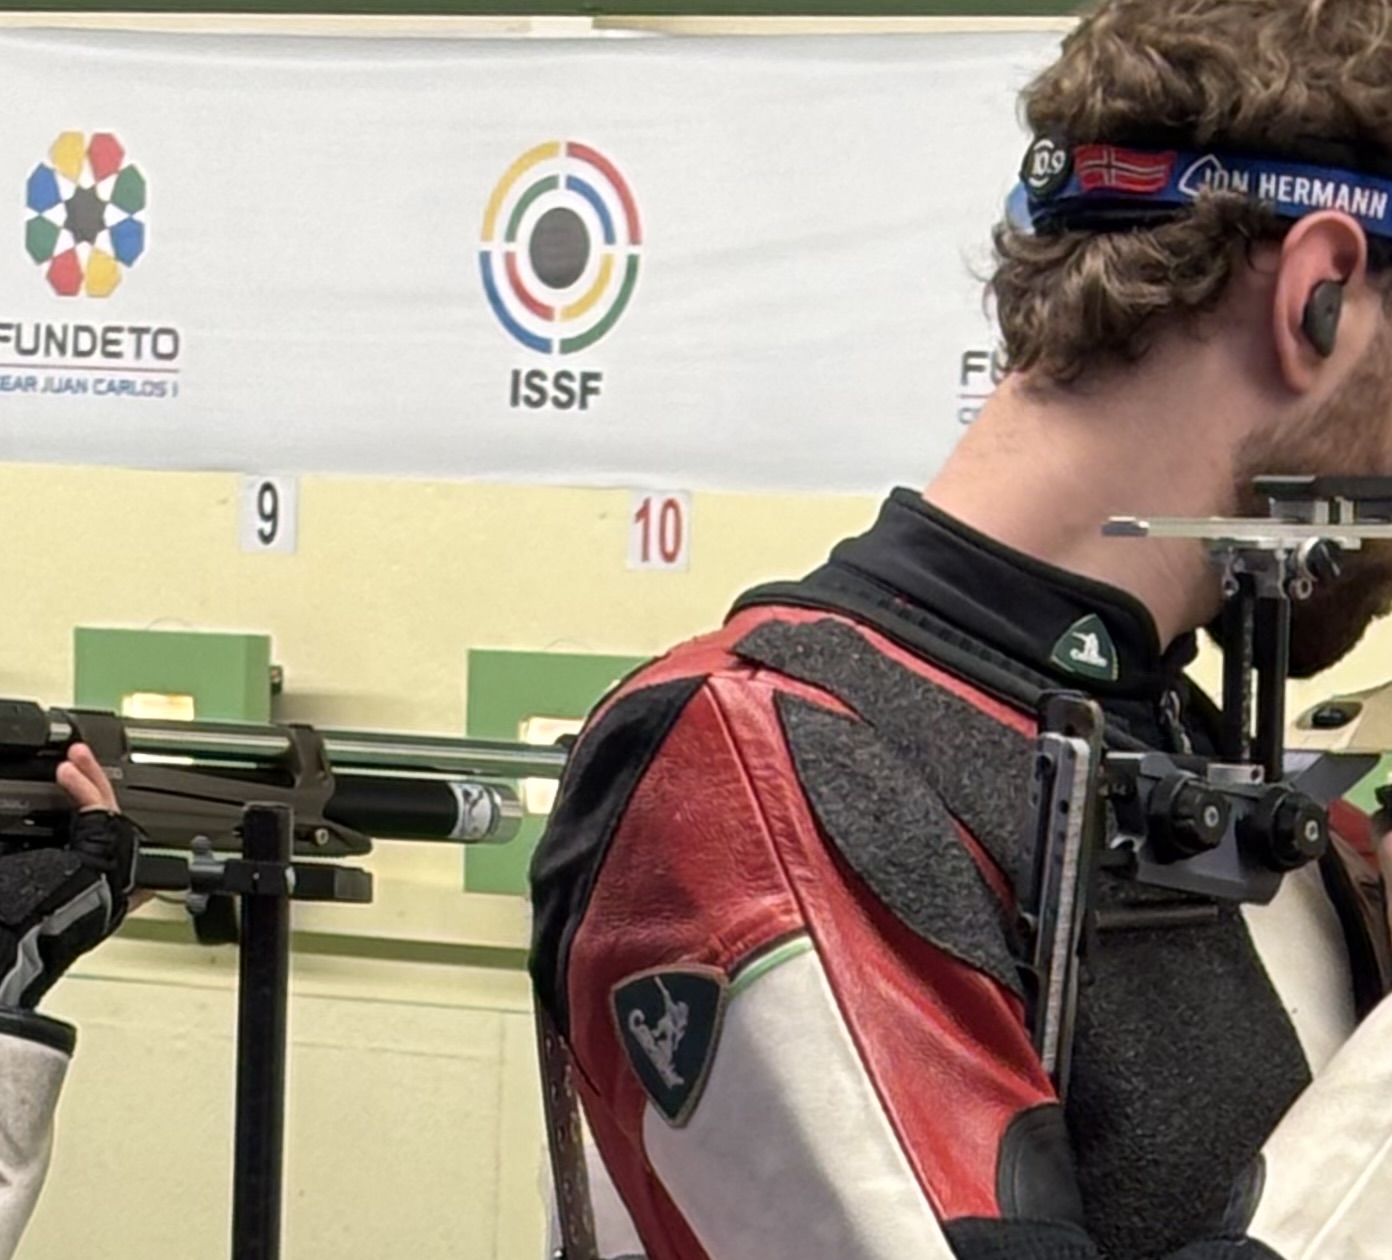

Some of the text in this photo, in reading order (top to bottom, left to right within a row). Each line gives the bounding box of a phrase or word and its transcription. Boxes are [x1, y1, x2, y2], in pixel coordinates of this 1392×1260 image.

[1258, 172, 1388, 220] HERMANN
[41, 377, 88, 394] JUAN
[92, 379, 167, 397] CARLOS
[510, 368, 603, 411] ISSF
[256, 482, 280, 546] 9
[634, 497, 683, 563] 10
